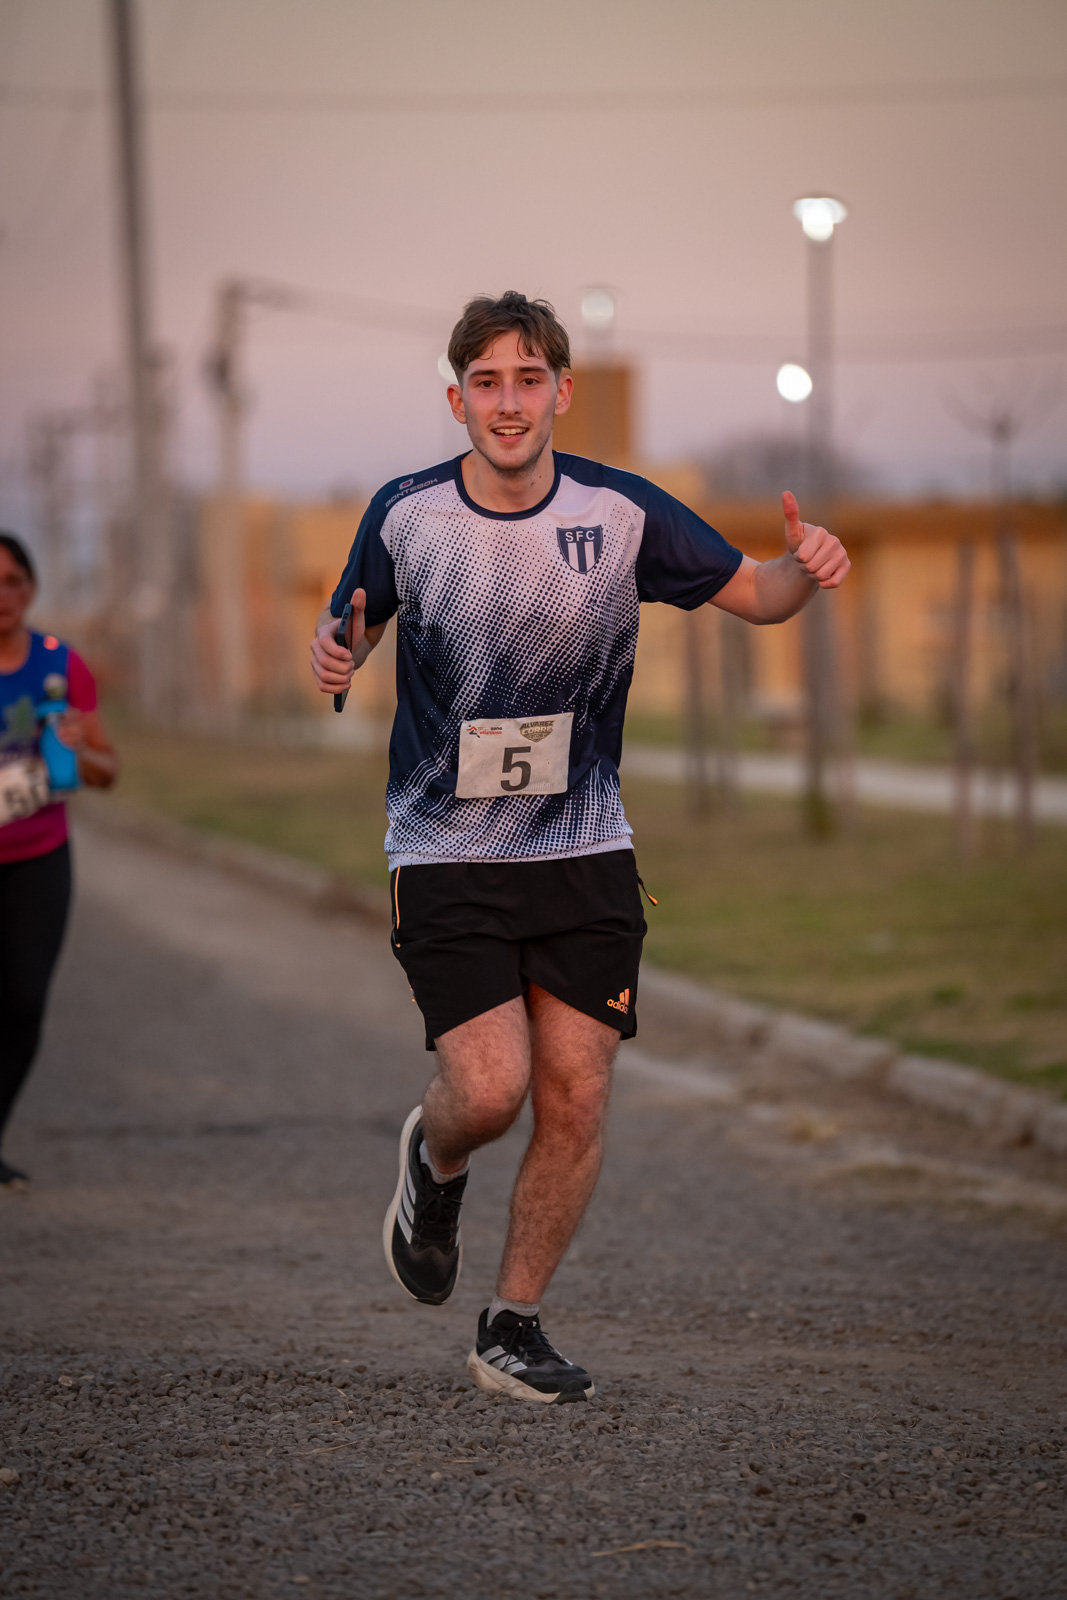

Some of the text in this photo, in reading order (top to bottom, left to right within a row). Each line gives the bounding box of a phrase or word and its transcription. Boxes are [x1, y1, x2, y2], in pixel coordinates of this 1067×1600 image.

[565, 530, 595, 542] SFC
[521, 720, 555, 729] ALVAREZ
[501, 746, 531, 792] 5
[606, 998, 629, 1014] adida
